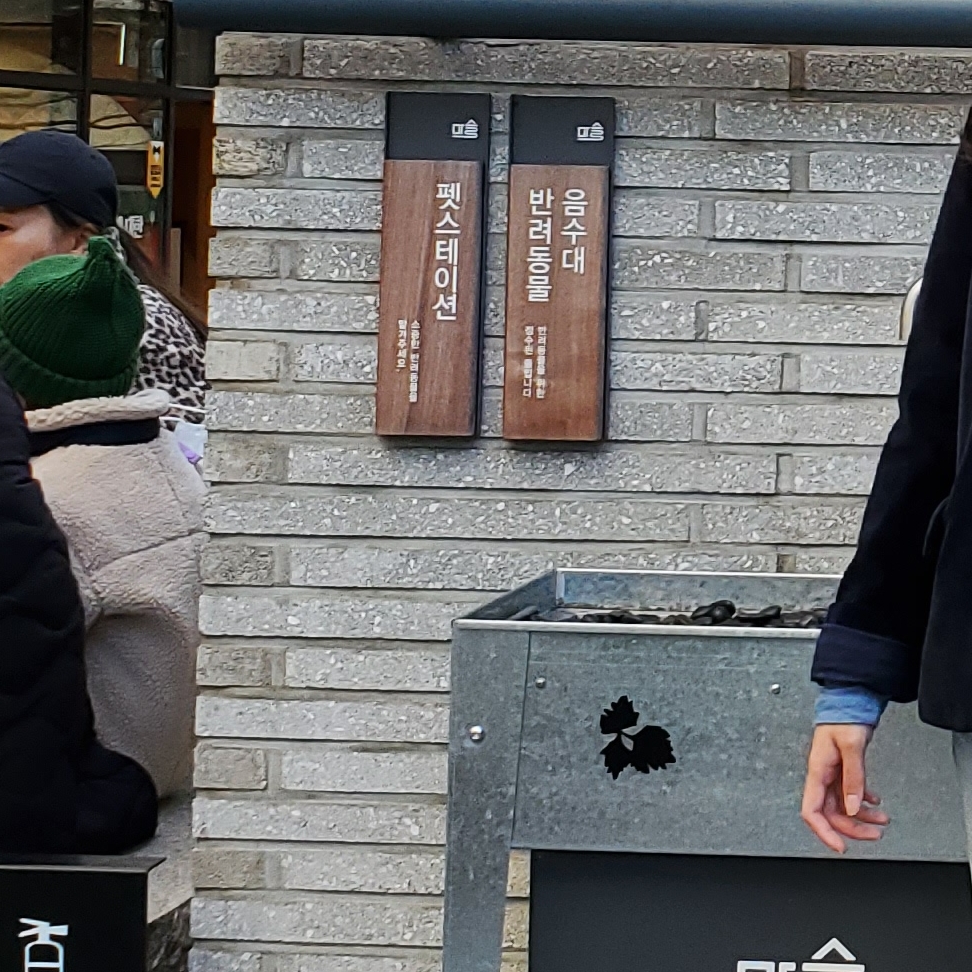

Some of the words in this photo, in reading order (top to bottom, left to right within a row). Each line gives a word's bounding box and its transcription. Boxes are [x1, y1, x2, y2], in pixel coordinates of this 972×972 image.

[432, 182, 461, 321] 펫스테이션
[525, 188, 556, 302] 반려동물
[560, 188, 589, 275] 음수대
